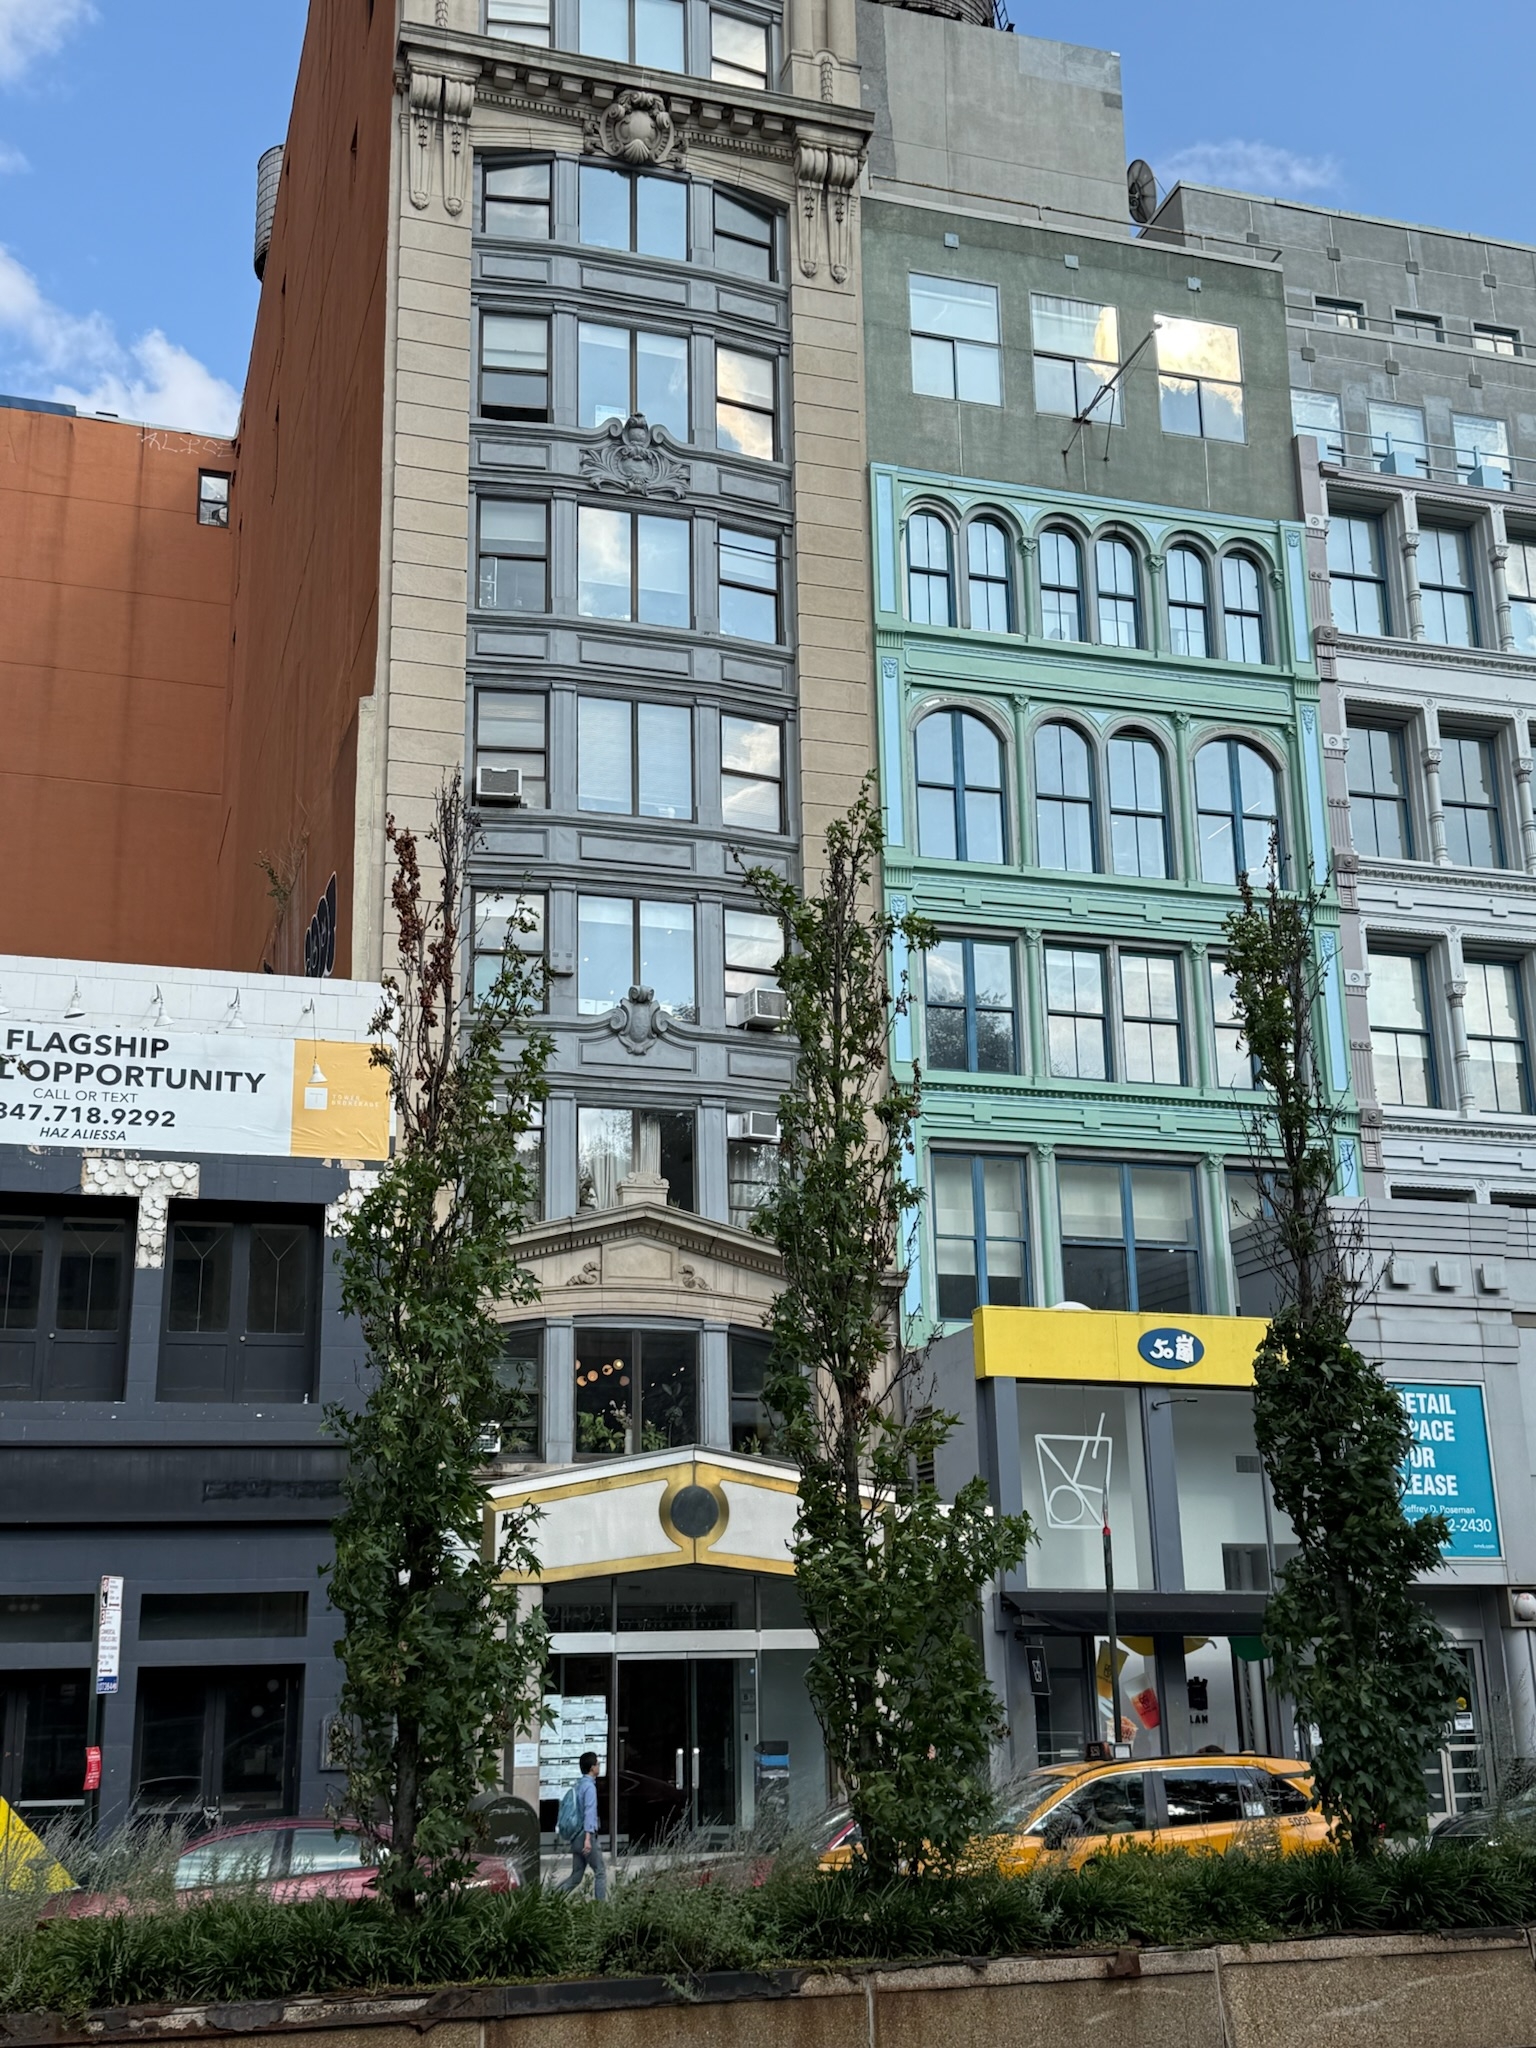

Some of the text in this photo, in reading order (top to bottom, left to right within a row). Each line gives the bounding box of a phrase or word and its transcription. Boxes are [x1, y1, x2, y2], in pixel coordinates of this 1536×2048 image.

[6, 1029, 169, 1059] FLAGSHIP
[24, 1059, 266, 1093] OPPORTUNITY
[33, 1088, 139, 1103] CALL OR TEXT
[39, 1127, 127, 1141] HAZ ALIESSA
[1401, 1419, 1456, 1442] PACE
[1397, 1446, 1436, 1468] OR
[666, 1603, 707, 1613] PLAZA
